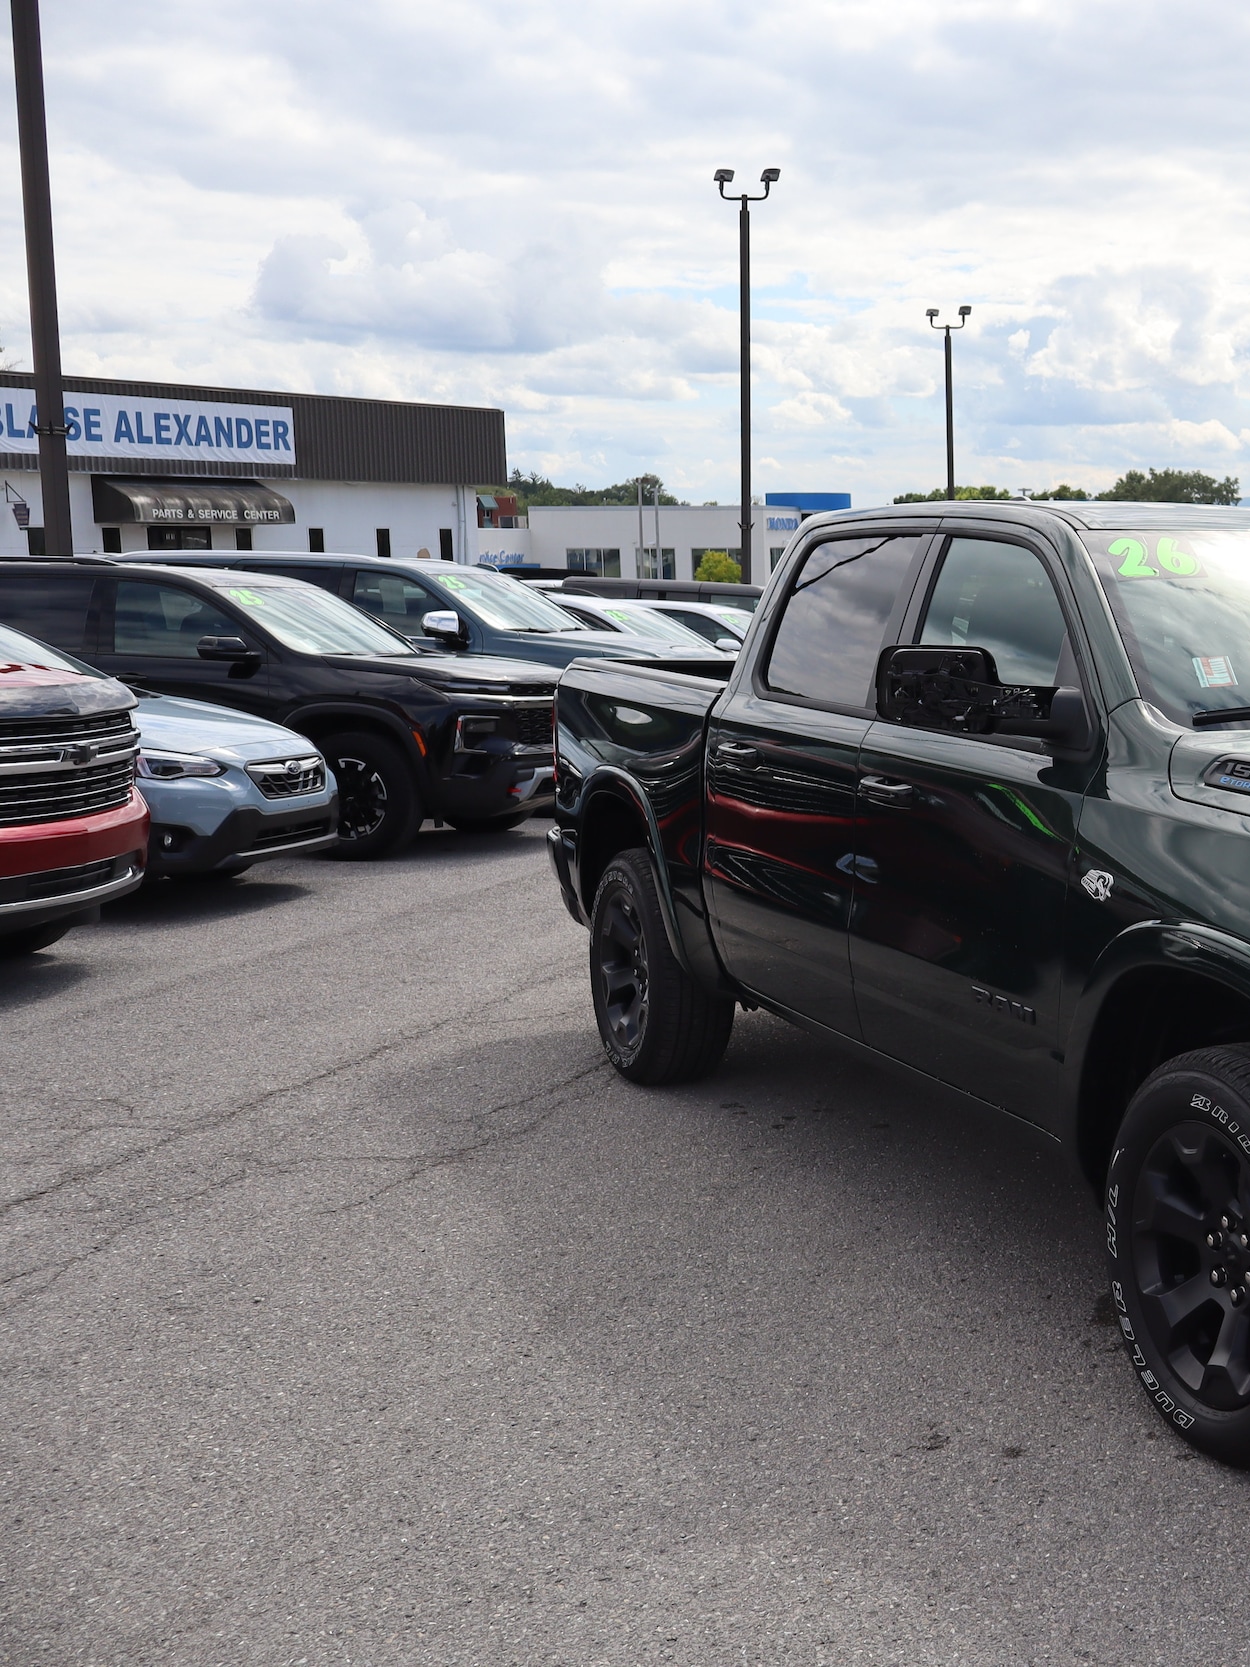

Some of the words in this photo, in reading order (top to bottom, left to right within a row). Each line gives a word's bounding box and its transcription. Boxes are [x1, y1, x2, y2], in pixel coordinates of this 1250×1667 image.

[114, 410, 292, 451] ALEXANDER
[152, 508, 183, 519] PARTS
[187, 509, 194, 519] &
[198, 509, 238, 520] SERVICE
[244, 510, 280, 520] CENTER
[767, 516, 799, 531] HONDA
[1107, 537, 1198, 578] 26
[438, 575, 467, 590] 25
[229, 589, 264, 607] 25
[1112, 1281, 1196, 1430] DUELER
